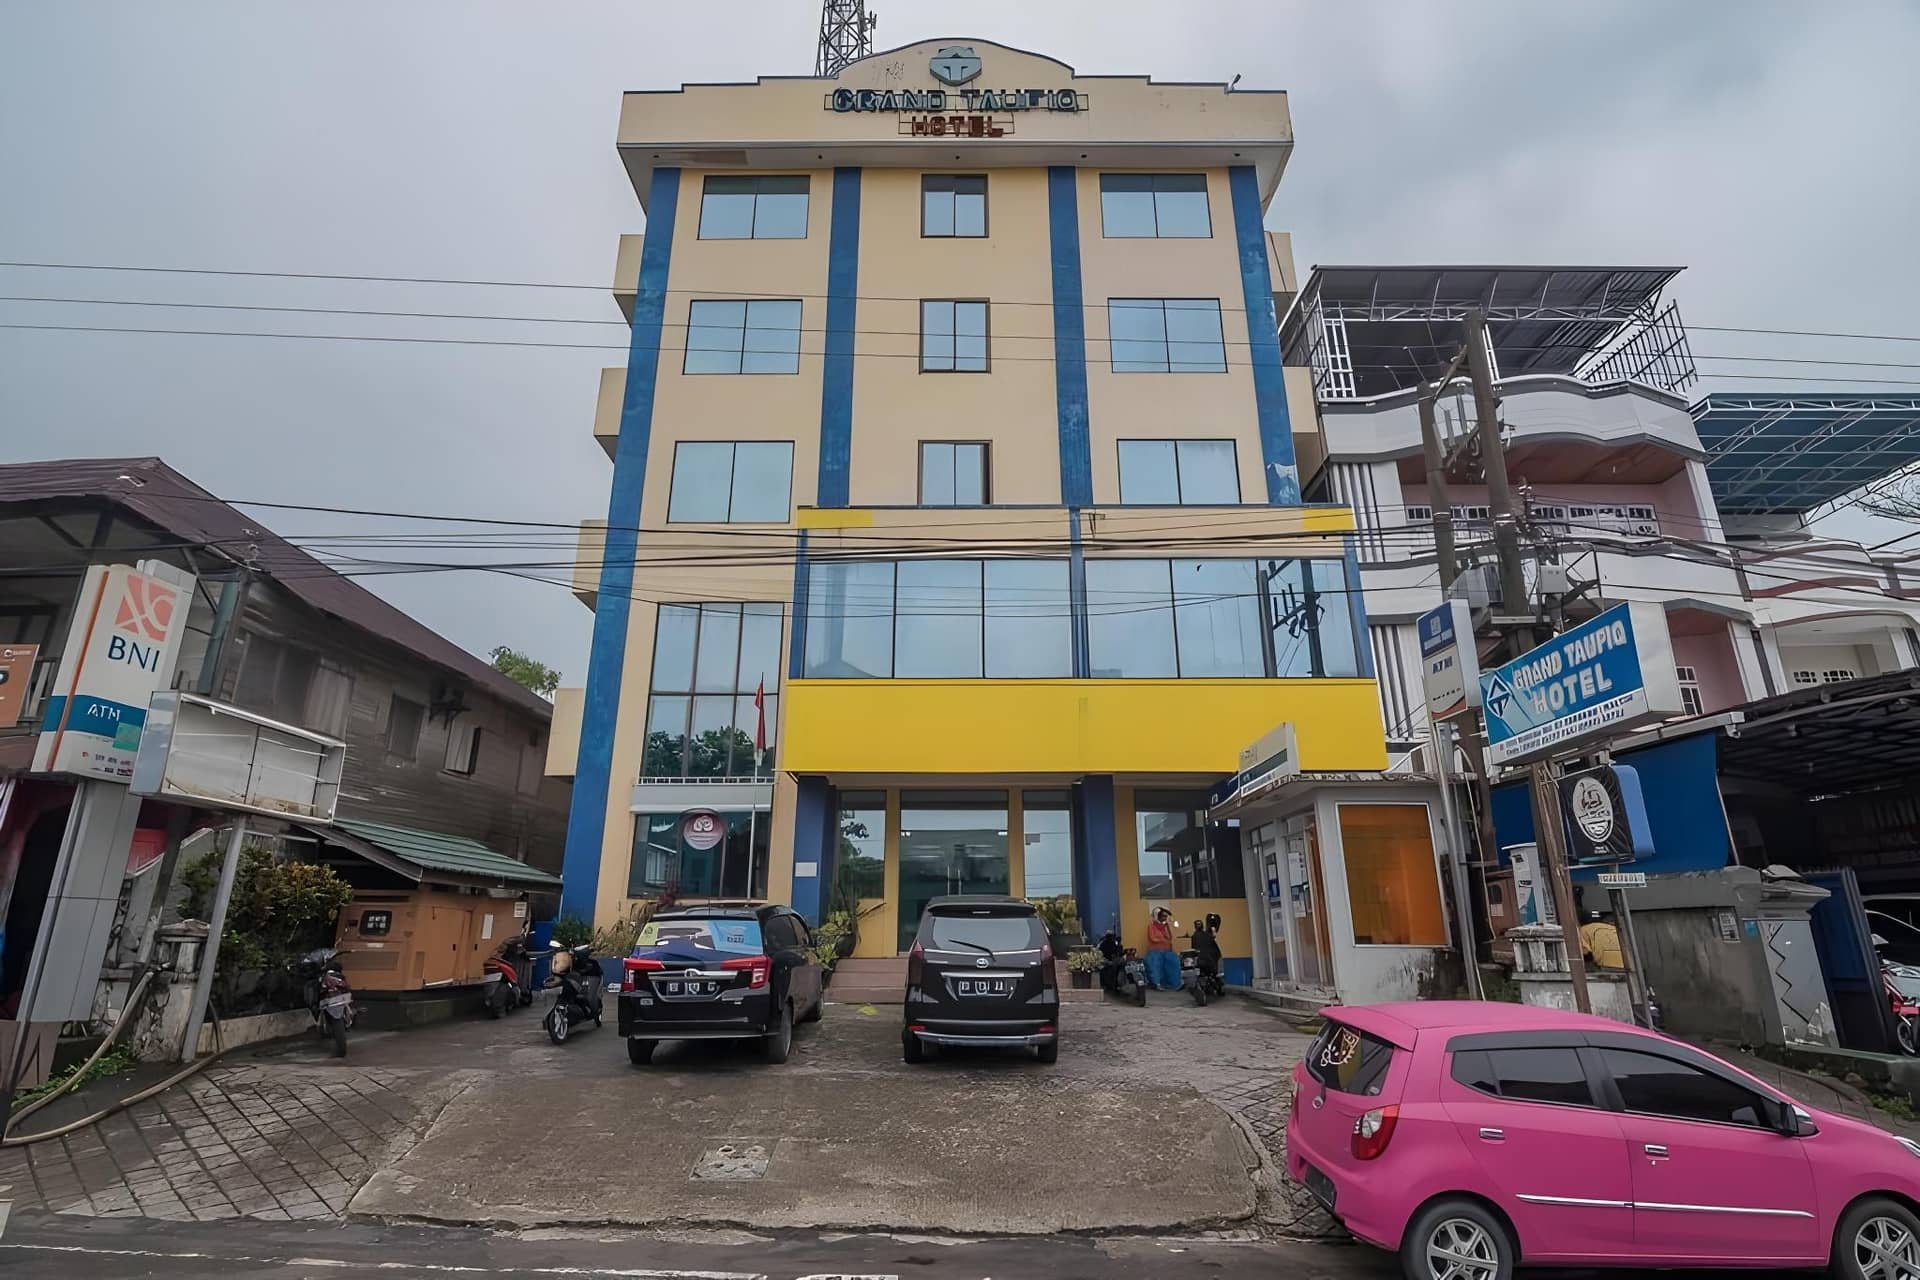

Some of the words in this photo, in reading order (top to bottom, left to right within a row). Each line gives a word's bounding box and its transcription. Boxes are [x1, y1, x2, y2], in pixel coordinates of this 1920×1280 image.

[832, 88, 946, 113] GRAND
[912, 115, 1004, 138] HOTEL
[107, 634, 160, 673] BNI
[1532, 663, 1613, 714] HOTEL
[87, 703, 120, 722] ATM
